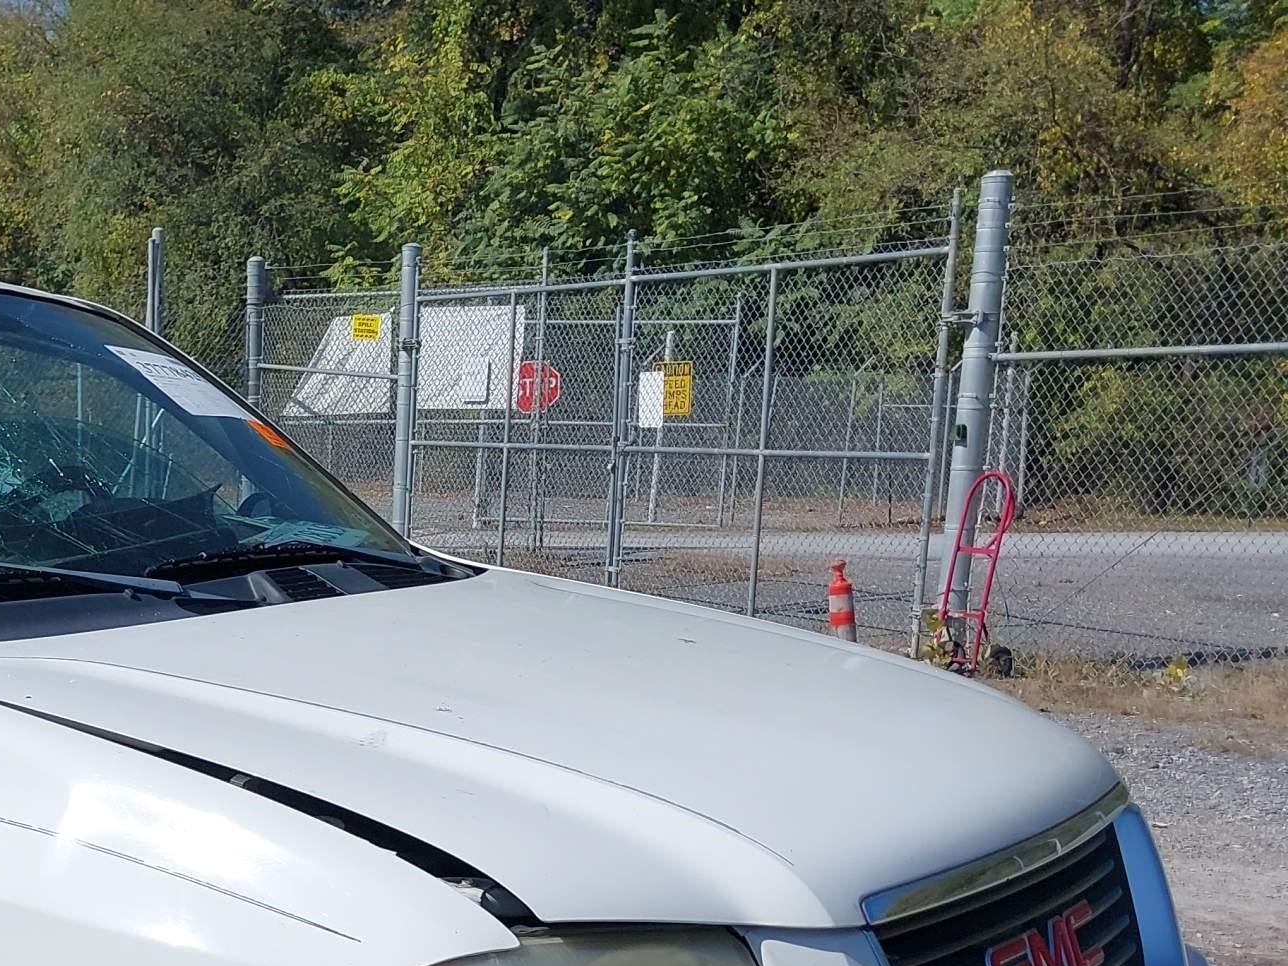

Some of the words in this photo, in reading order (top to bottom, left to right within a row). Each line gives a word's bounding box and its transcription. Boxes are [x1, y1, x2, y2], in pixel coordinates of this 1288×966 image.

[663, 379, 686, 389] PEED
[663, 390, 688, 400] UMPS
[663, 400, 686, 410] HEAD
